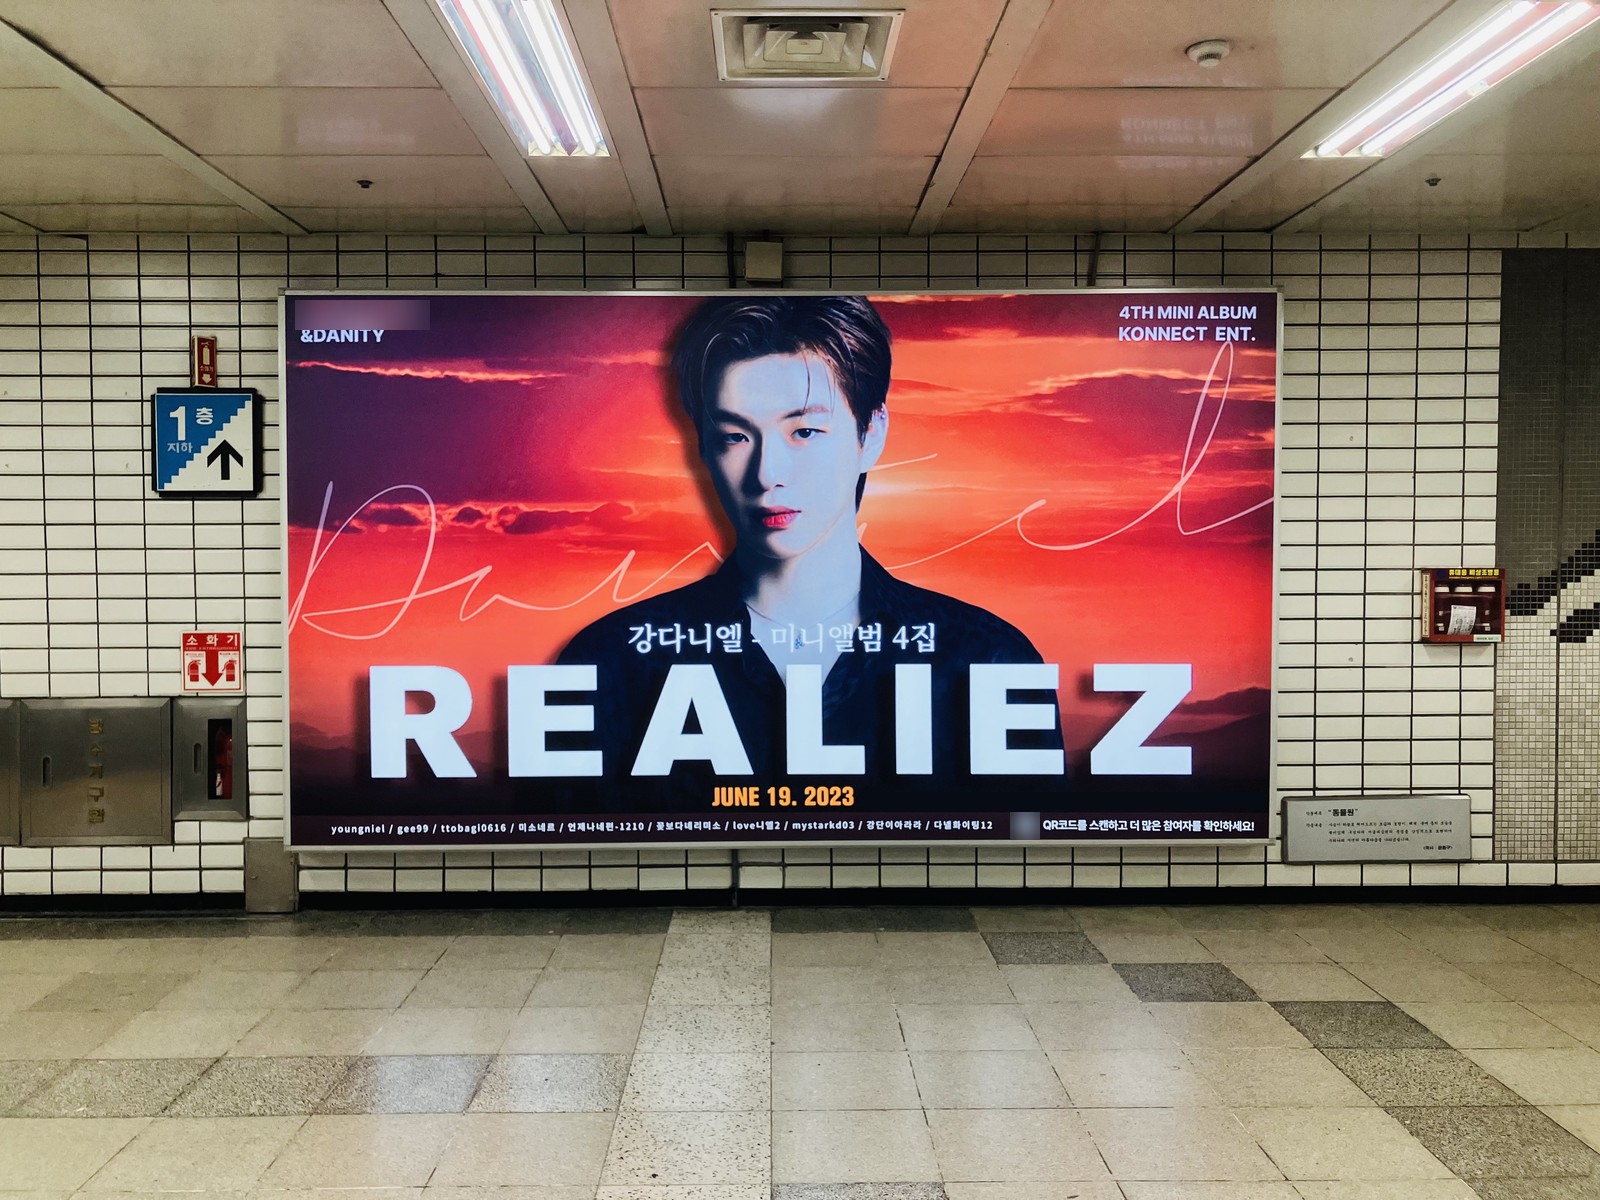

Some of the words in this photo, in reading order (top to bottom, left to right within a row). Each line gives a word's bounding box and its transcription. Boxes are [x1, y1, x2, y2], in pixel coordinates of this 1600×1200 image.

[1119, 305, 1154, 320] 4TH
[1157, 305, 1194, 320] MINI
[1197, 305, 1257, 320] ALBUM
[300, 329, 385, 343] &DANITY
[1119, 326, 1208, 341] KONNECT
[1215, 326, 1256, 341] ENT.
[167, 442, 193, 454] 지하
[628, 622, 744, 653] 강다니엘
[771, 622, 882, 653] 미니앨범
[892, 622, 936, 653] 4집
[368, 662, 1194, 779] REALIEZ
[712, 786, 760, 807] JUNE
[767, 786, 797, 807] 19.
[804, 785, 855, 807] 2023
[331, 823, 385, 835] youngniel
[397, 823, 429, 835] gee99
[440, 823, 506, 835] ttobagi0616
[791, 820, 855, 831] mystarkd03
[1042, 820, 1087, 832] QR코드를
[1089, 819, 1128, 832] 스캔하고
[1130, 819, 1140, 832] 더
[1142, 820, 1162, 832] 많은
[1163, 820, 1202, 832] 참여자를
[1204, 820, 1255, 833] 확인하세요!
